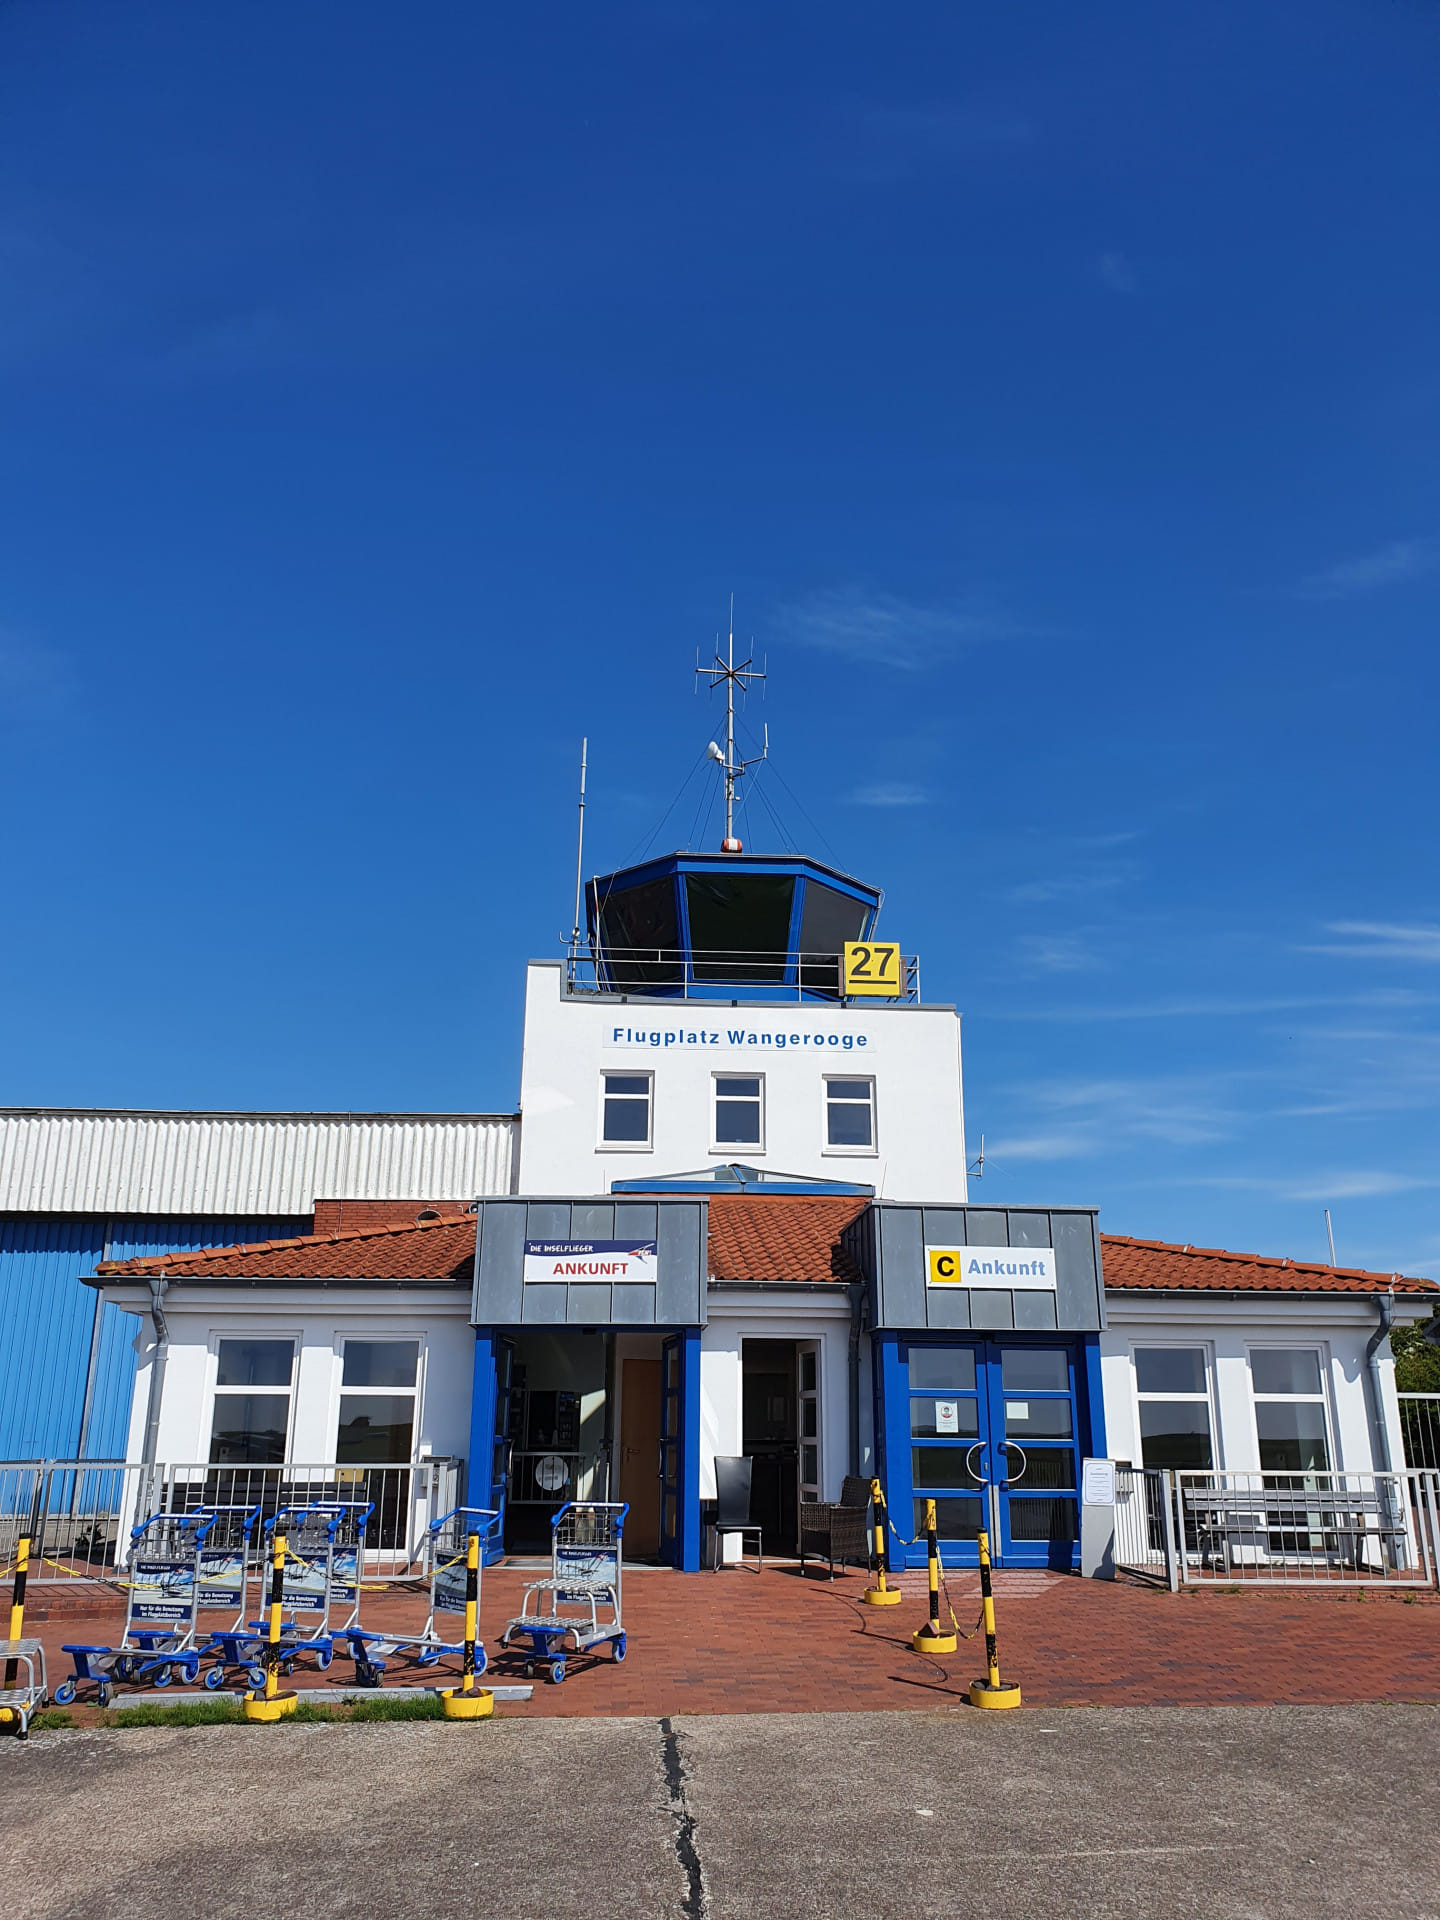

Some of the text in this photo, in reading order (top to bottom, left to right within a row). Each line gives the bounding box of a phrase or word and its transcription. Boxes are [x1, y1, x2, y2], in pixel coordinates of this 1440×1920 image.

[850, 946, 895, 977] 27
[612, 1027, 868, 1049] Flugplatz Wangerooge
[530, 1244, 541, 1252] DIE
[553, 1263, 629, 1275] ANKUNFT
[936, 1256, 1046, 1277] C Ankunft
